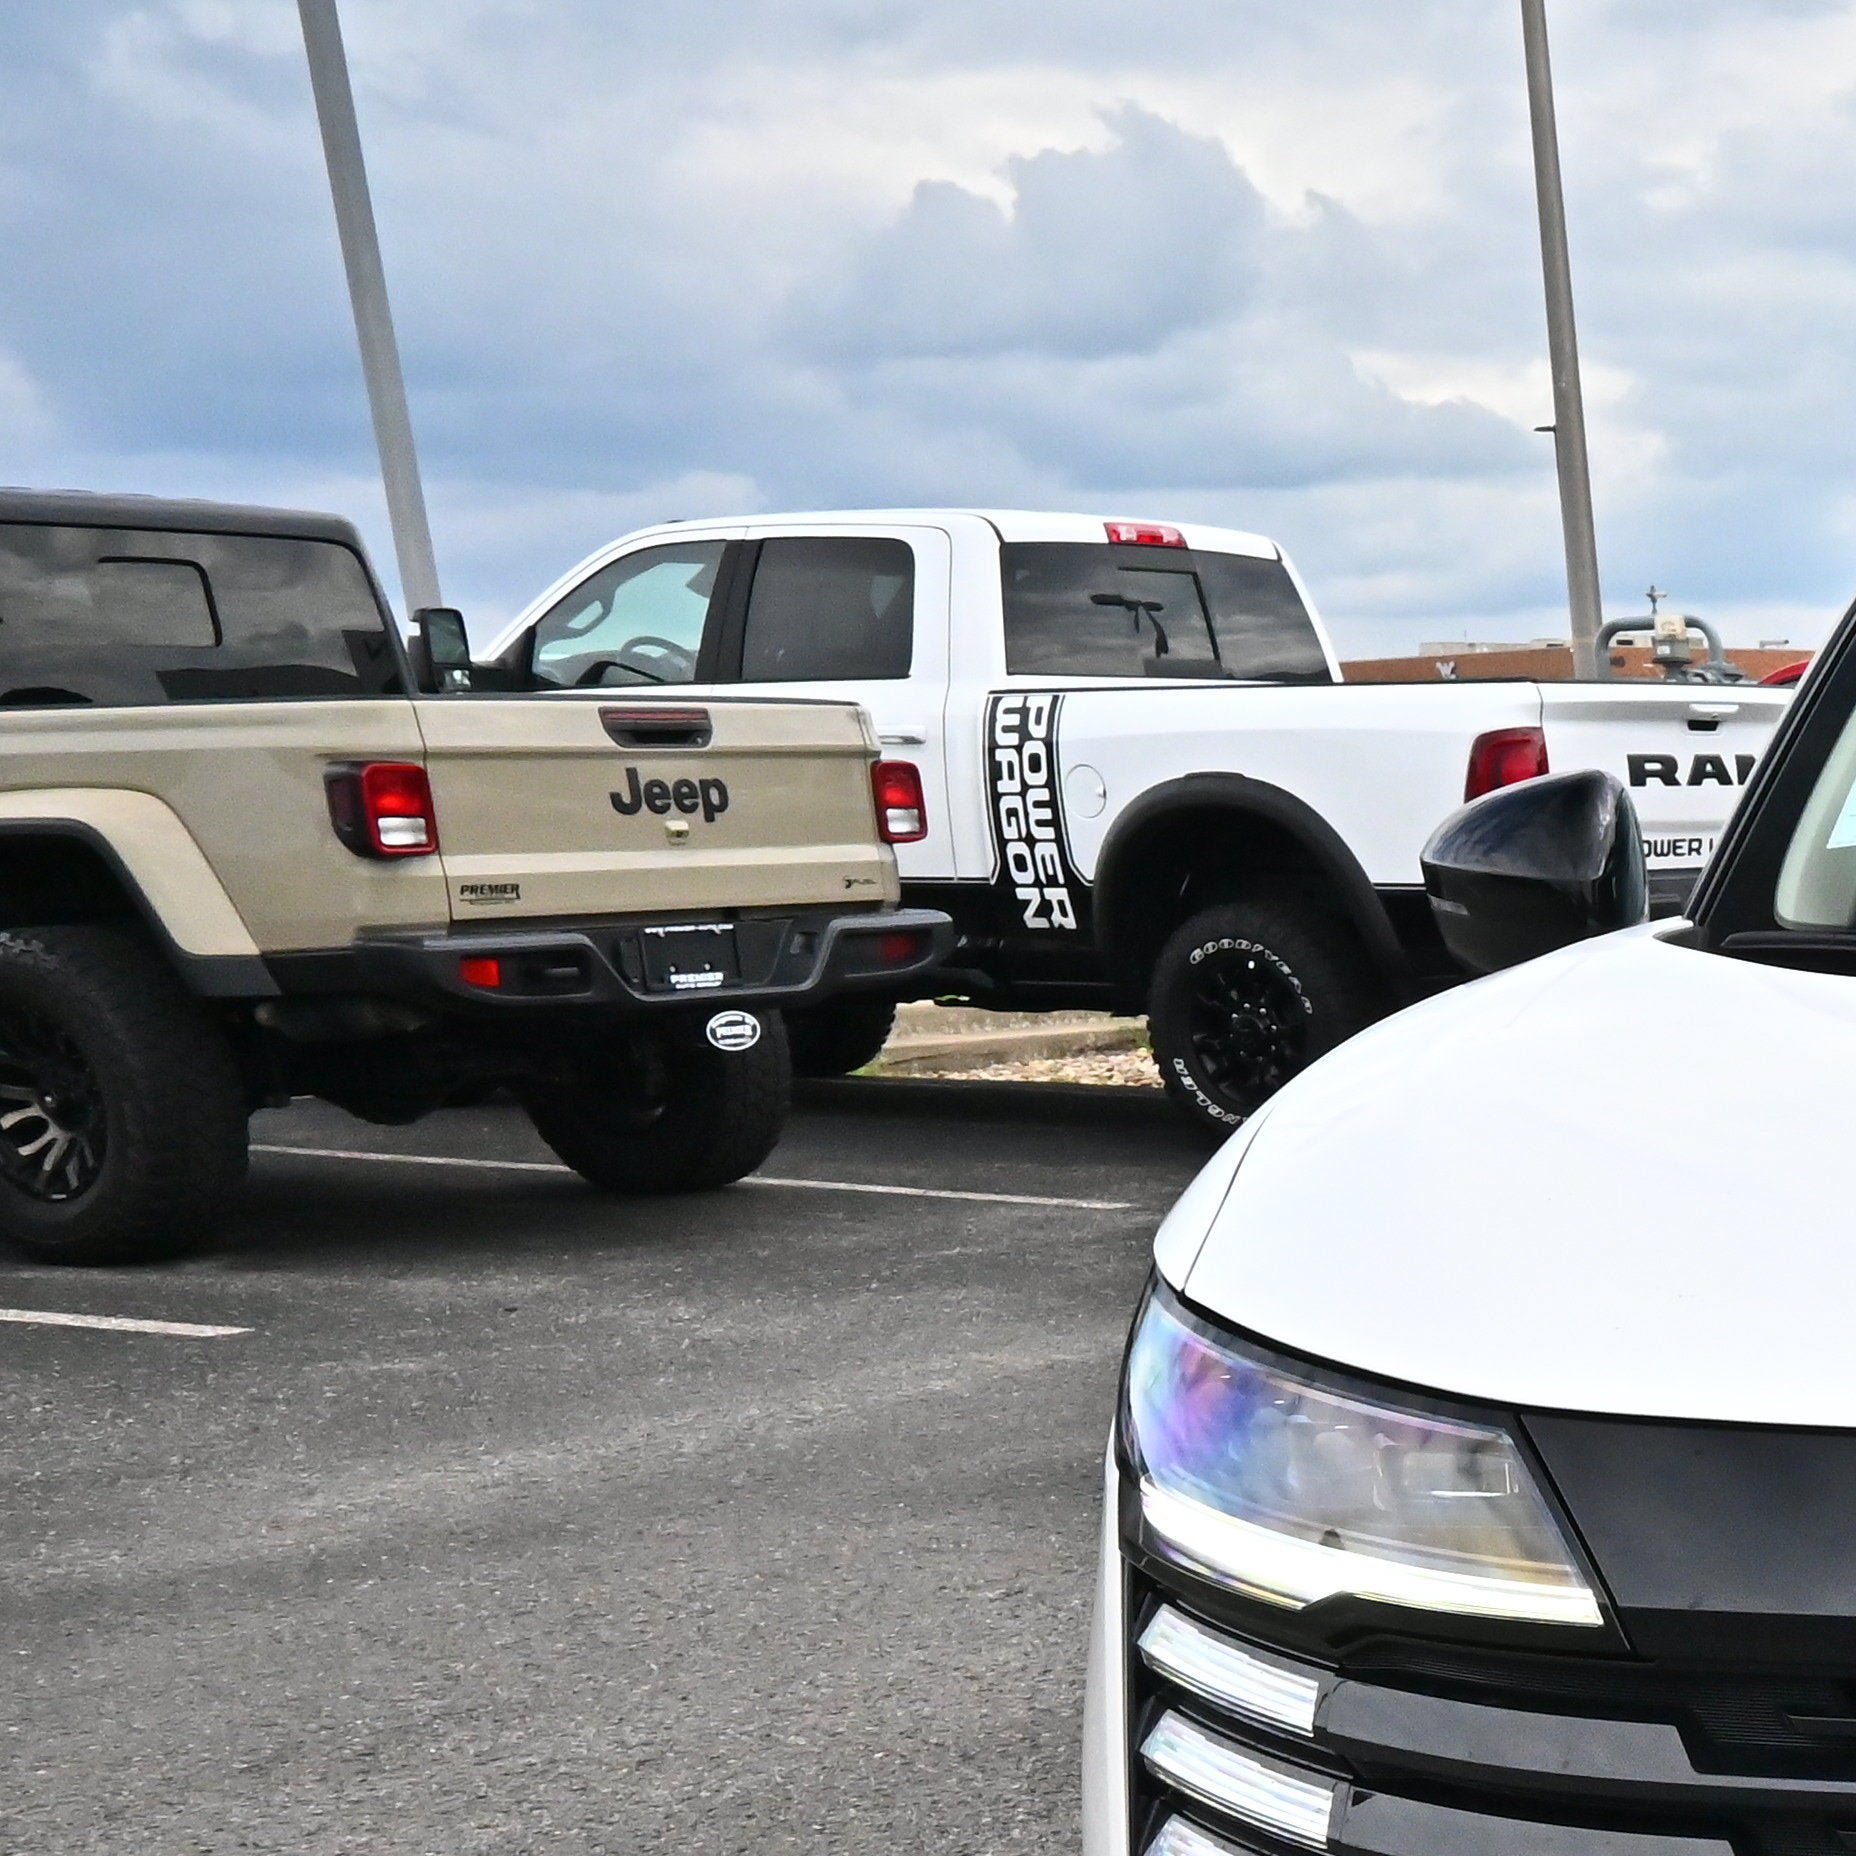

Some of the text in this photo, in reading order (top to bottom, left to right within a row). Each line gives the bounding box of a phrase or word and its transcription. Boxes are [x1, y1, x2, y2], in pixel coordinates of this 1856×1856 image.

[609, 767, 729, 823] Jeep
[995, 696, 1050, 929] WAGON
[1025, 696, 1078, 930] POWER
[1643, 838, 1703, 862] OWER
